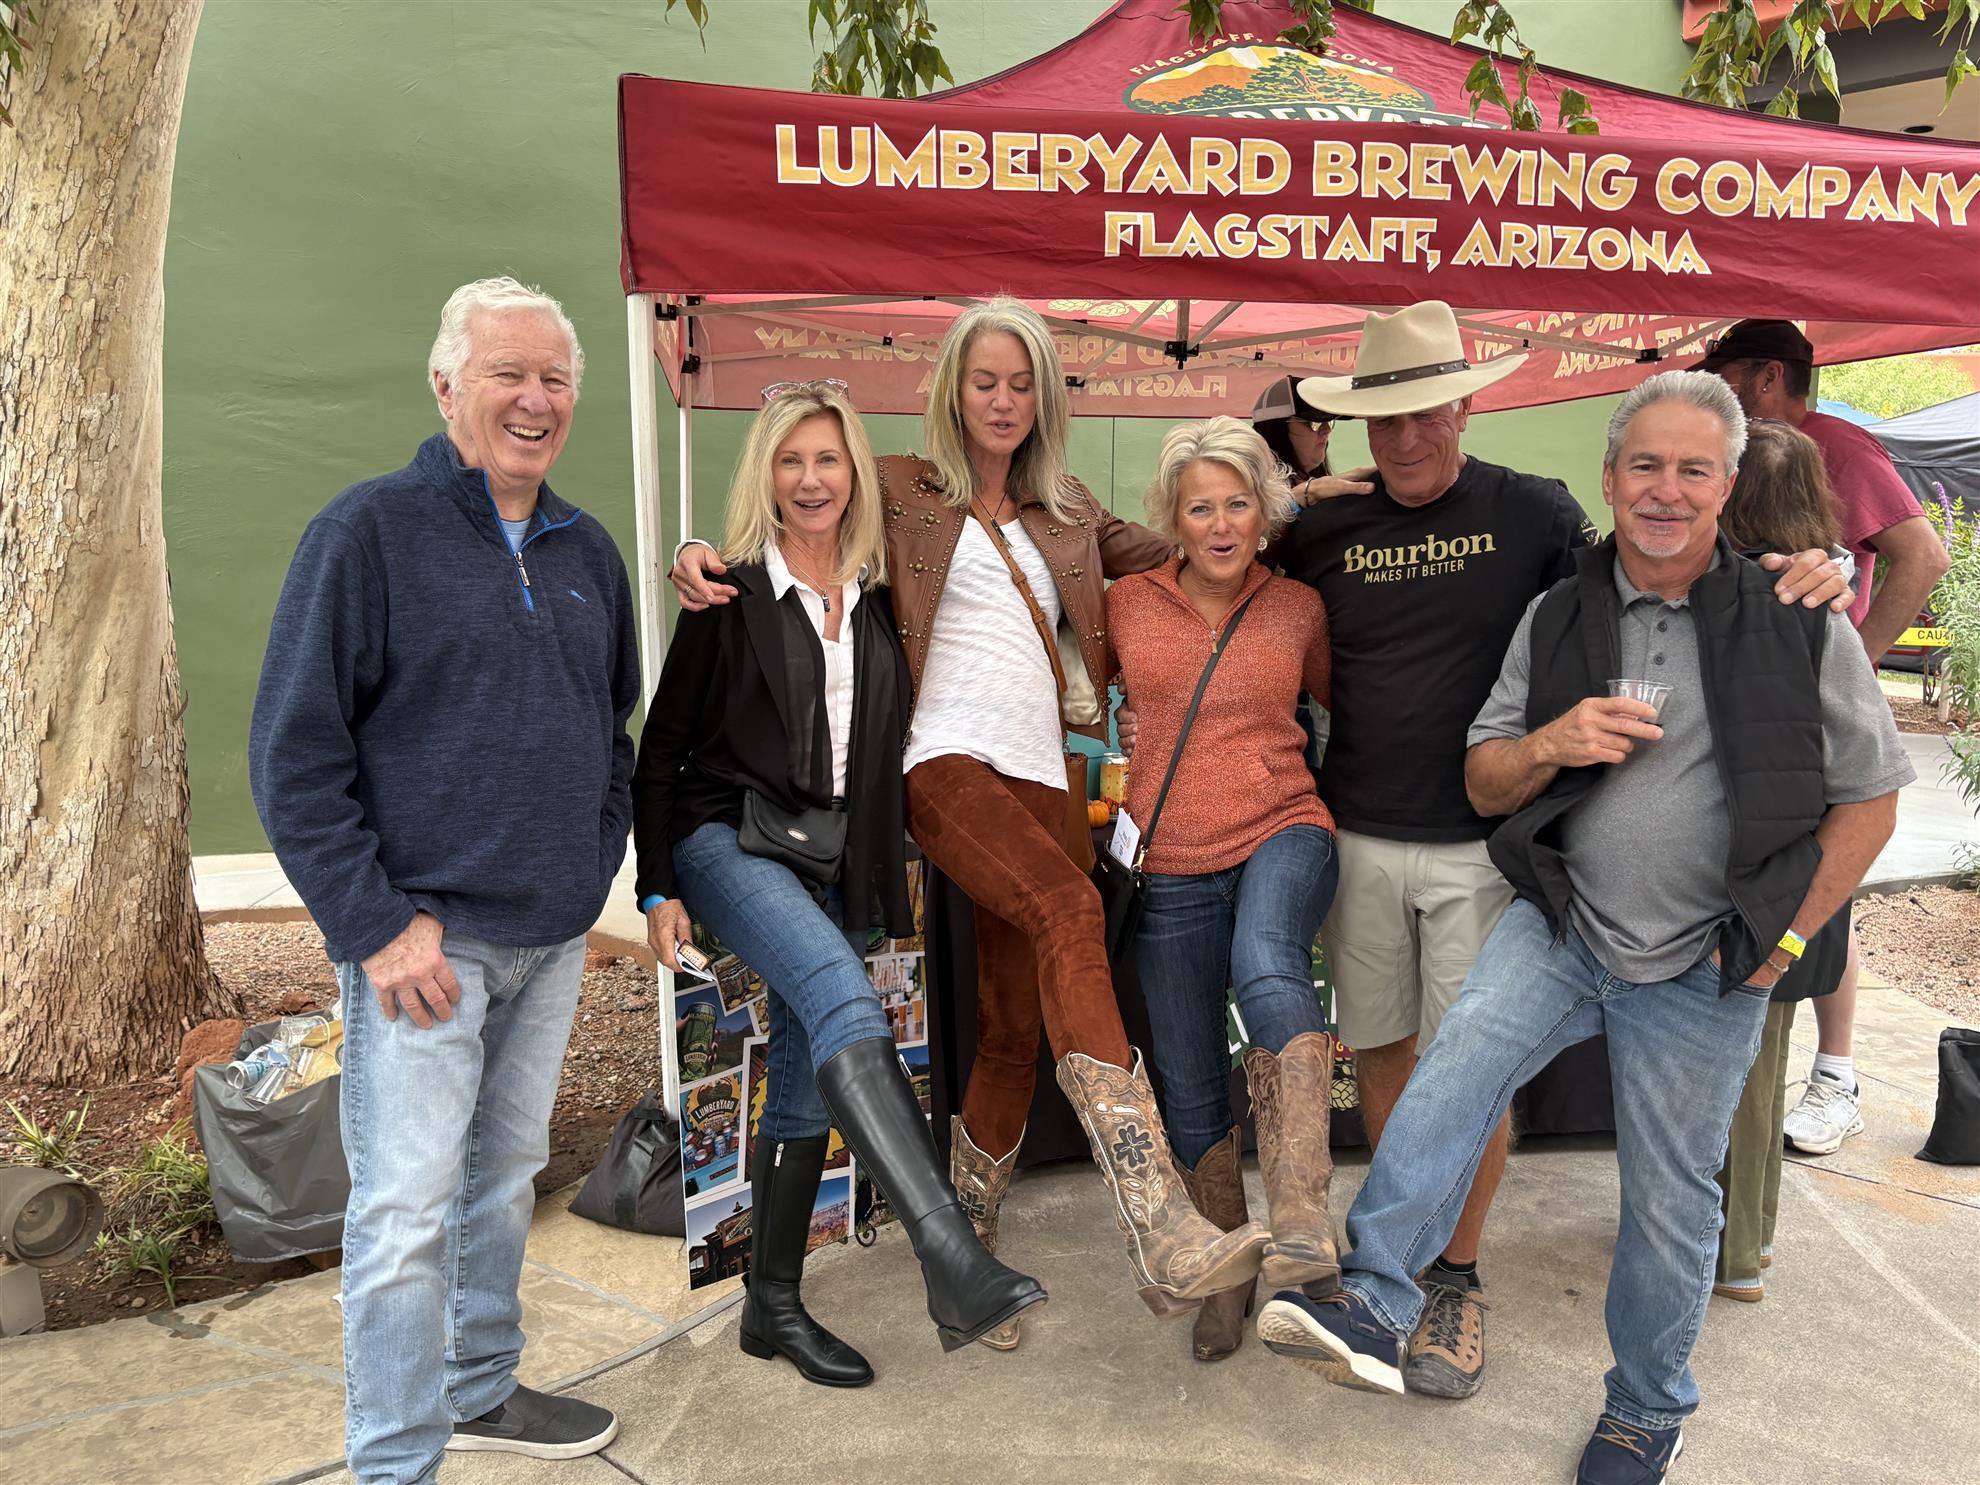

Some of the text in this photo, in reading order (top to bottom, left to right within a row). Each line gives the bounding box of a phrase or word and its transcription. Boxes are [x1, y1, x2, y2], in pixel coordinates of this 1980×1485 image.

[775, 122, 1980, 228] LUMBERYARD BREWING COMPANY
[1104, 210, 1713, 276] FLAGSTAFF, ARIZONA
[1343, 532, 1497, 573] Bourbon
[1364, 559, 1465, 583] MAKES IT BETTER
[695, 1100, 735, 1120] LUMBERYARD
